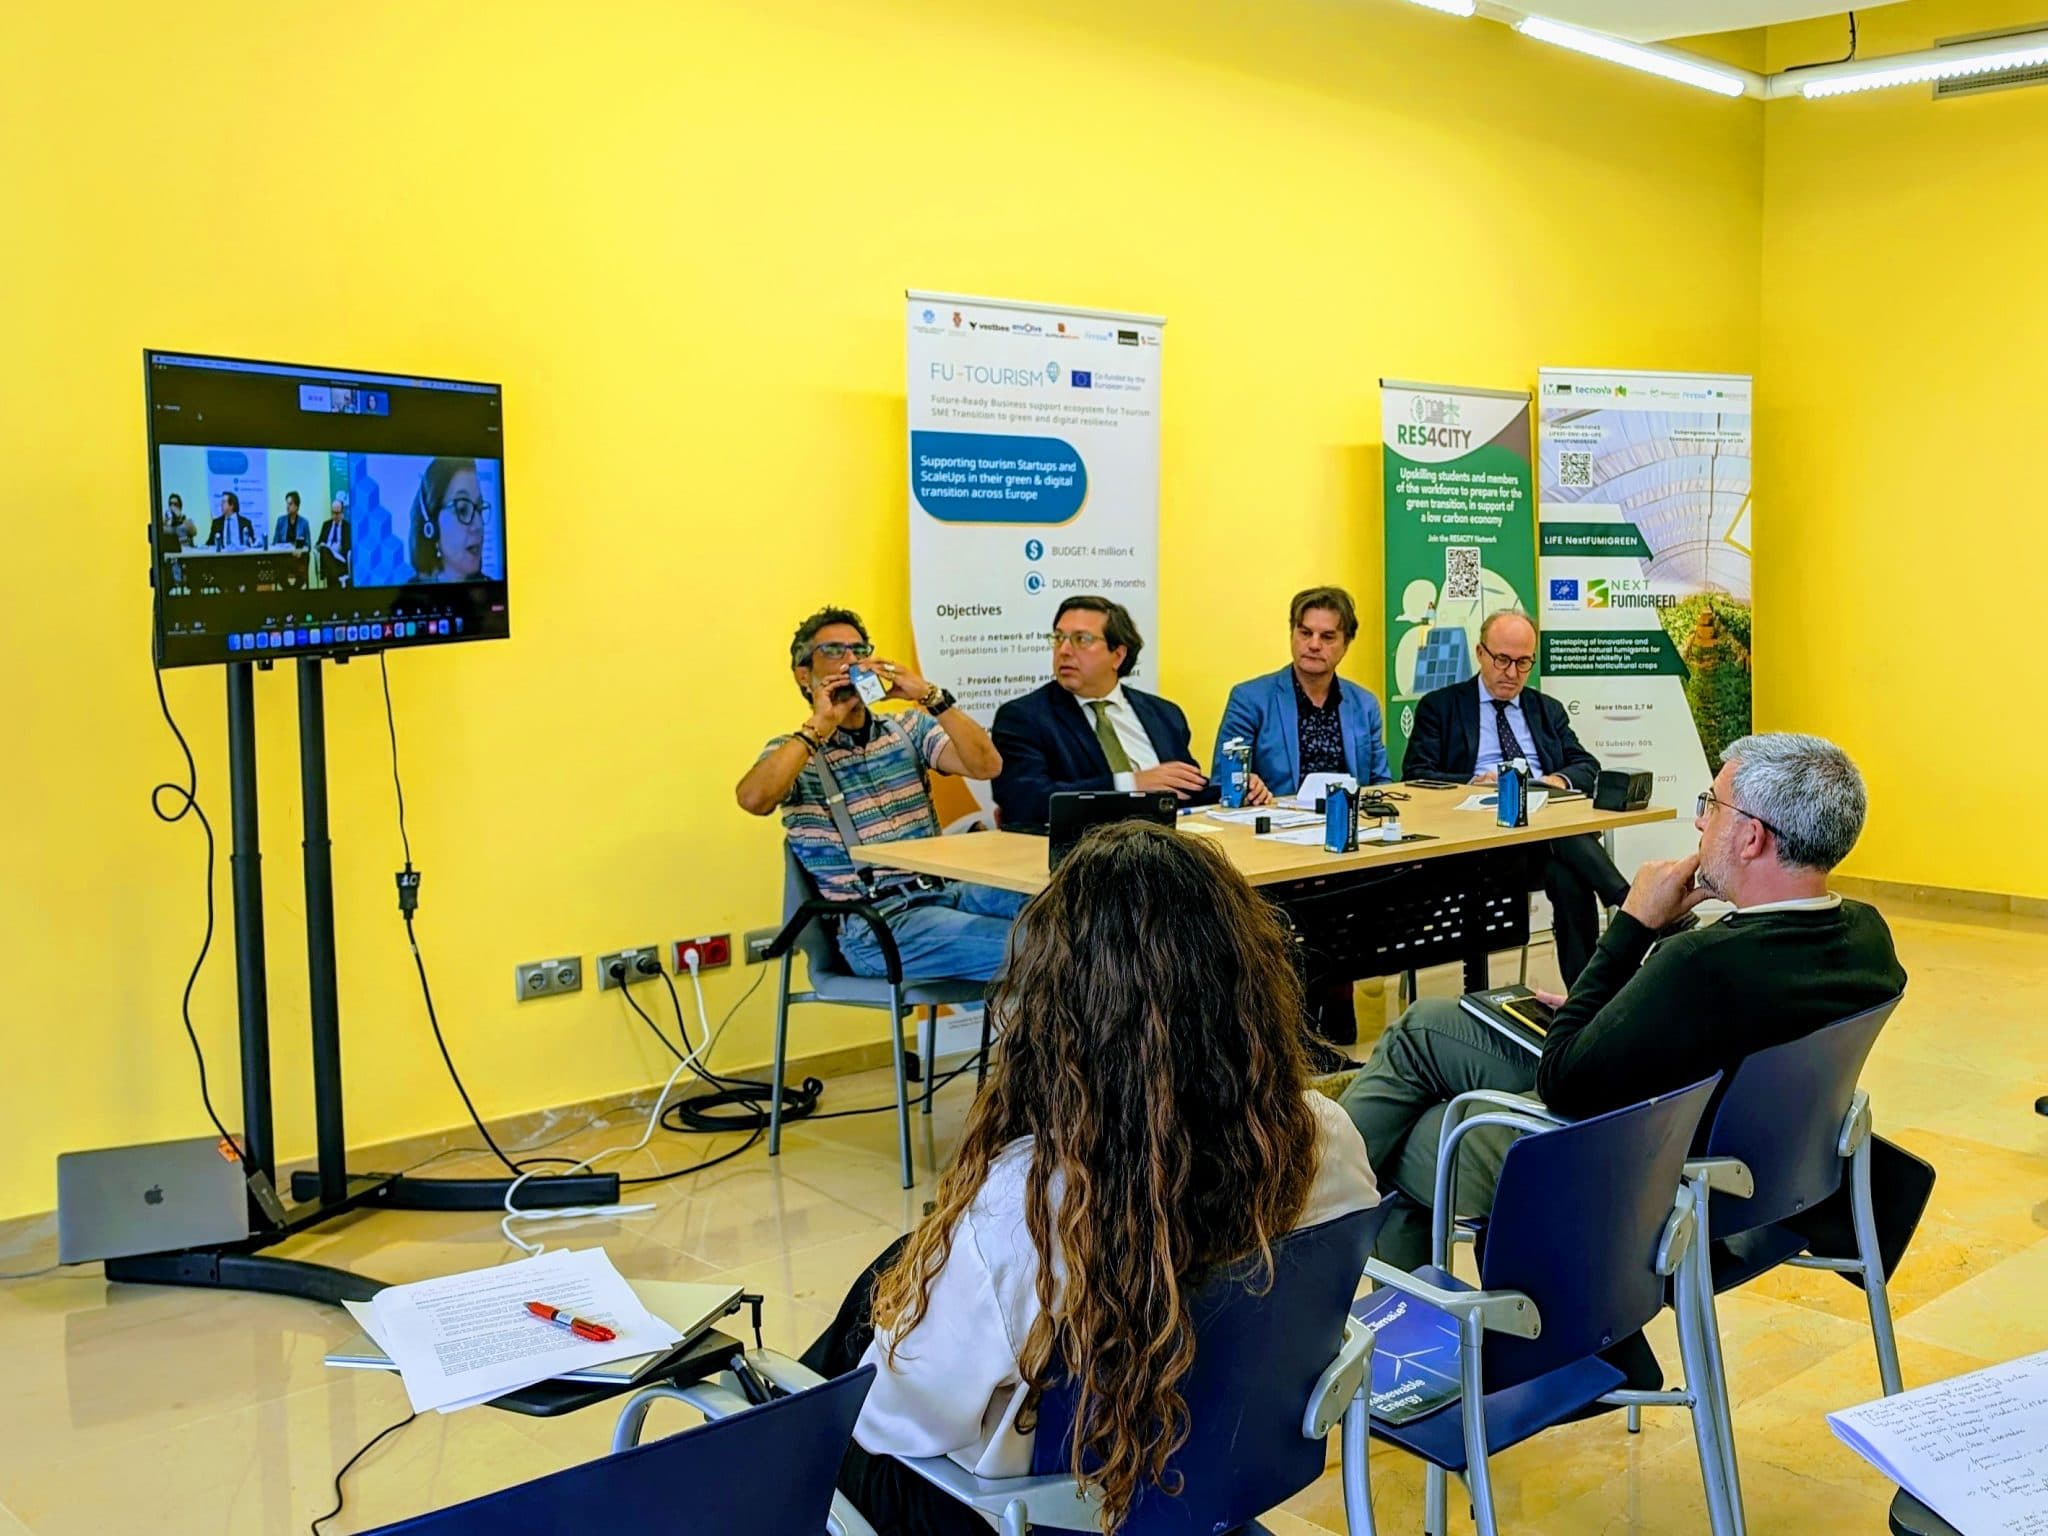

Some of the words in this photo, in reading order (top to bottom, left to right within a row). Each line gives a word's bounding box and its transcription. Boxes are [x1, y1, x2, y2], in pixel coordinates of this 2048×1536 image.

[1094, 381, 1123, 391] European
[1575, 385, 1611, 394] tecnova
[931, 394, 989, 408] Future-Ready
[991, 398, 1027, 409] Business
[1029, 401, 1061, 412] support
[1063, 403, 1104, 415] ecosystem
[1106, 404, 1118, 415] for
[1120, 407, 1150, 417] Tourism
[931, 408, 949, 417] SME
[953, 409, 995, 420] Transition
[997, 411, 1007, 421] to
[1009, 414, 1033, 424] green
[1035, 413, 1050, 424] and
[1052, 414, 1079, 427] digital
[1080, 416, 1118, 427] resilience
[1397, 424, 1472, 449] RES4CITY
[920, 455, 976, 471] Supporting
[978, 458, 1016, 470] tourism
[1017, 459, 1057, 472] Startups
[1058, 462, 1077, 472] and
[920, 470, 966, 485] ScaleUps
[968, 472, 978, 483] in
[979, 472, 1003, 484] their
[1005, 476, 1032, 488] green
[1034, 475, 1042, 485] &
[1043, 475, 1073, 489] digital
[1400, 467, 1437, 483] Upskilling
[1438, 470, 1470, 482] students
[1471, 472, 1485, 483] and
[1486, 473, 1519, 485] members
[920, 487, 969, 498] transition
[971, 490, 1003, 499] across
[1005, 488, 1038, 502] Europe
[1396, 481, 1405, 493] of
[1406, 482, 1419, 494] the
[1421, 483, 1459, 496] workforce
[1460, 486, 1469, 496] to
[1470, 488, 1498, 499] prepare
[1499, 486, 1509, 498] for
[1510, 488, 1522, 499] the
[1406, 500, 1429, 511] green
[1430, 498, 1468, 511] transition,
[1468, 500, 1476, 510] in
[1477, 501, 1505, 513] support
[1506, 500, 1514, 512] of
[1421, 514, 1426, 523] a
[1427, 511, 1441, 523] low
[1442, 512, 1468, 524] carbon
[1469, 516, 1503, 528] economy
[1428, 534, 1438, 542] Join
[1439, 534, 1448, 542] the
[1449, 534, 1473, 542] RES4CITY
[1474, 535, 1497, 543] Network
[1544, 536, 1563, 545] LIFE
[1566, 536, 1638, 546] NextFUMIGREEN
[1052, 546, 1089, 556] BUDGET:
[1091, 546, 1097, 556] 4
[1098, 546, 1127, 556] million
[1129, 547, 1135, 556] €
[1052, 579, 1100, 588] DURATION:
[1101, 578, 1112, 588] 36
[1113, 578, 1146, 588] months
[1611, 580, 1649, 591] NEXT
[1611, 594, 1676, 609] FUMIGREEN
[936, 604, 1002, 620] Objectives
[950, 634, 977, 643] Create
[987, 632, 1023, 641] network
[1025, 631, 1034, 640] of
[1550, 638, 1588, 646] Developing
[939, 645, 998, 657] organisations
[1000, 645, 1009, 654] in
[1017, 643, 1052, 654] Europea
[1613, 646, 1649, 654] fumigants
[1596, 654, 1622, 663] whitefly
[957, 677, 965, 686] 2.
[967, 676, 1001, 685] Provide
[1004, 674, 1036, 685] funding
[957, 689, 991, 700] projects
[994, 687, 1011, 697] that
[958, 702, 996, 711] practices
[1614, 703, 1632, 711] than
[1377, 1394, 1423, 1412] Energy
